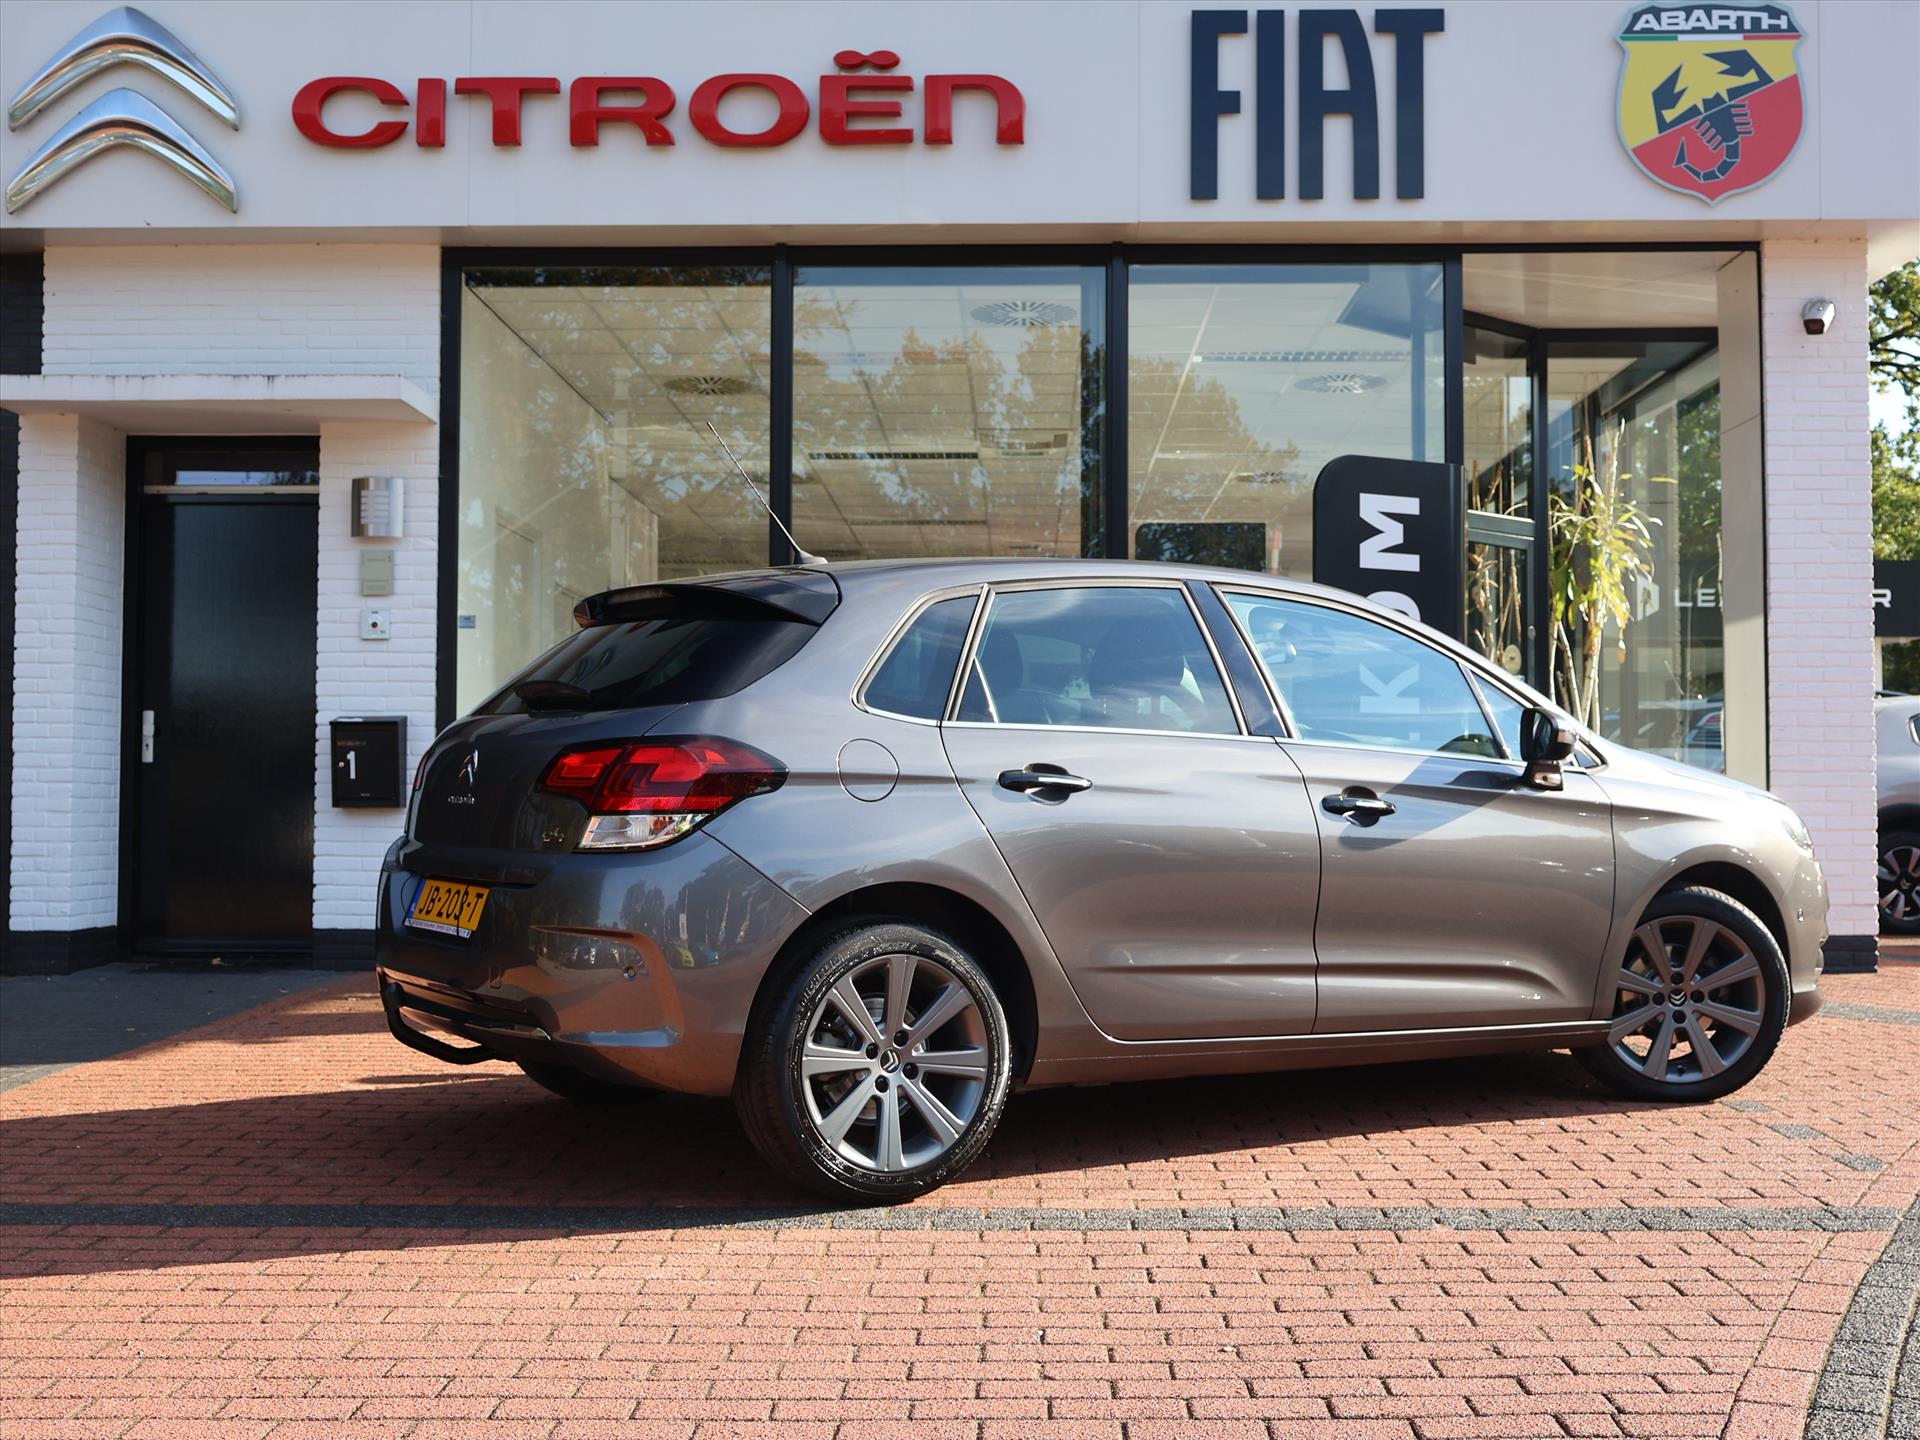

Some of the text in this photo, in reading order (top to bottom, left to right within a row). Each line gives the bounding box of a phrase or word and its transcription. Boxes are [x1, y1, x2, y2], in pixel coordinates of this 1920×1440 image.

[1632, 8, 1788, 31] ABARTH
[1190, 9, 1446, 201] FIAT
[346, 750, 356, 780] 1
